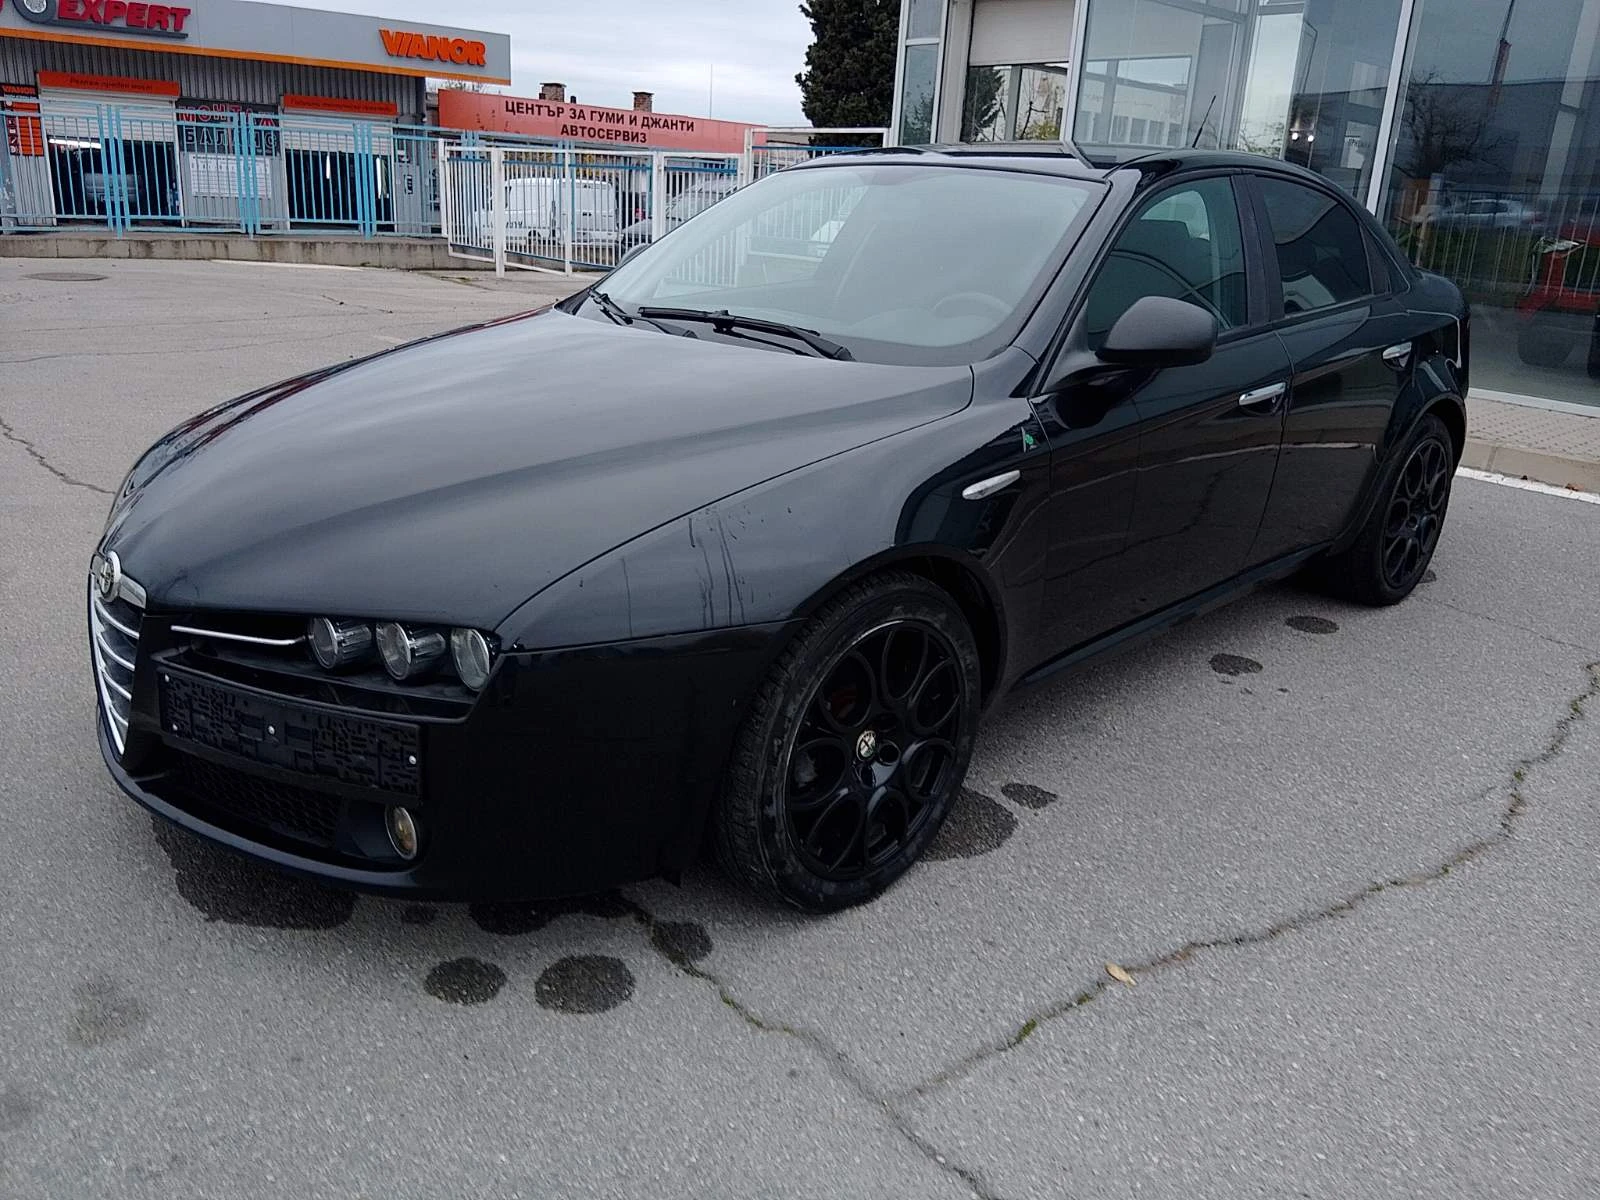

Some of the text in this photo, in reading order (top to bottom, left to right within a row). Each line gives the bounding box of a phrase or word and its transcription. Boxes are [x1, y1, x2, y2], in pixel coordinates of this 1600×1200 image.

[58, 0, 191, 32] EXPERT
[378, 29, 486, 66] VIANOR
[505, 100, 695, 132] ЦЕНТЪР ЗА ГУМИ И ДЖАНТИ
[184, 127, 277, 148] БАЛС
[560, 124, 648, 143] АВТОСЕРВИЗ
